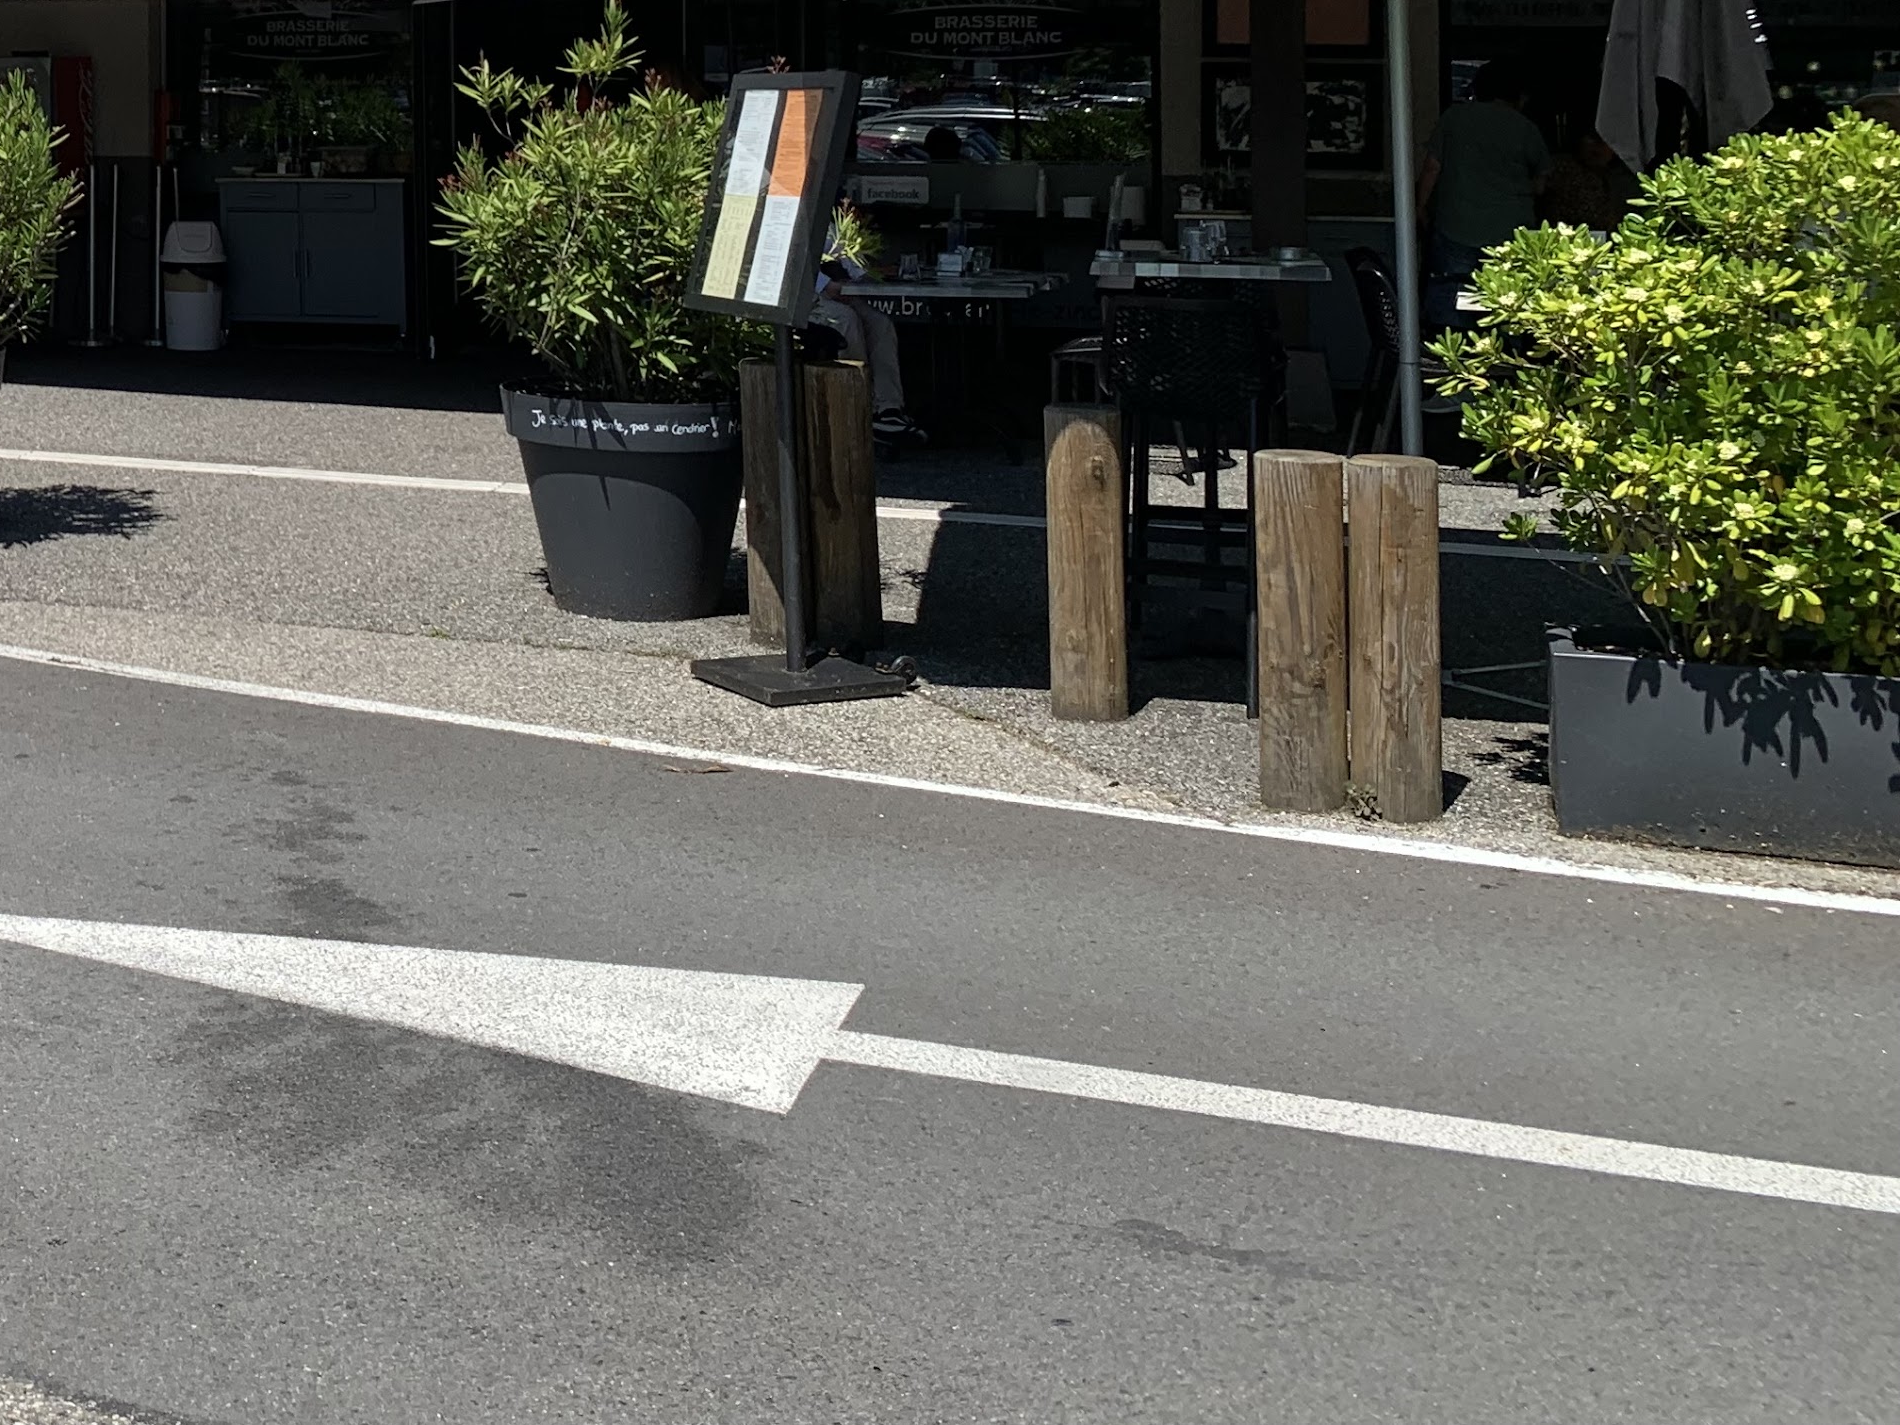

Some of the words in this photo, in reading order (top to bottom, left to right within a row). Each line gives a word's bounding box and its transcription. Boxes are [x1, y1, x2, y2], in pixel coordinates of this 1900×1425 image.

[265, 19, 350, 33] BRASSERIE
[933, 14, 1040, 30] BRASSERIE
[246, 34, 270, 47] DU
[273, 34, 317, 47] MONT
[317, 34, 371, 47] BLANC
[909, 31, 937, 46] DU
[942, 31, 997, 46] MONT
[998, 31, 1063, 45] BLANC
[867, 187, 920, 199] facebook
[531, 409, 547, 428] Je
[629, 422, 650, 436] pas
